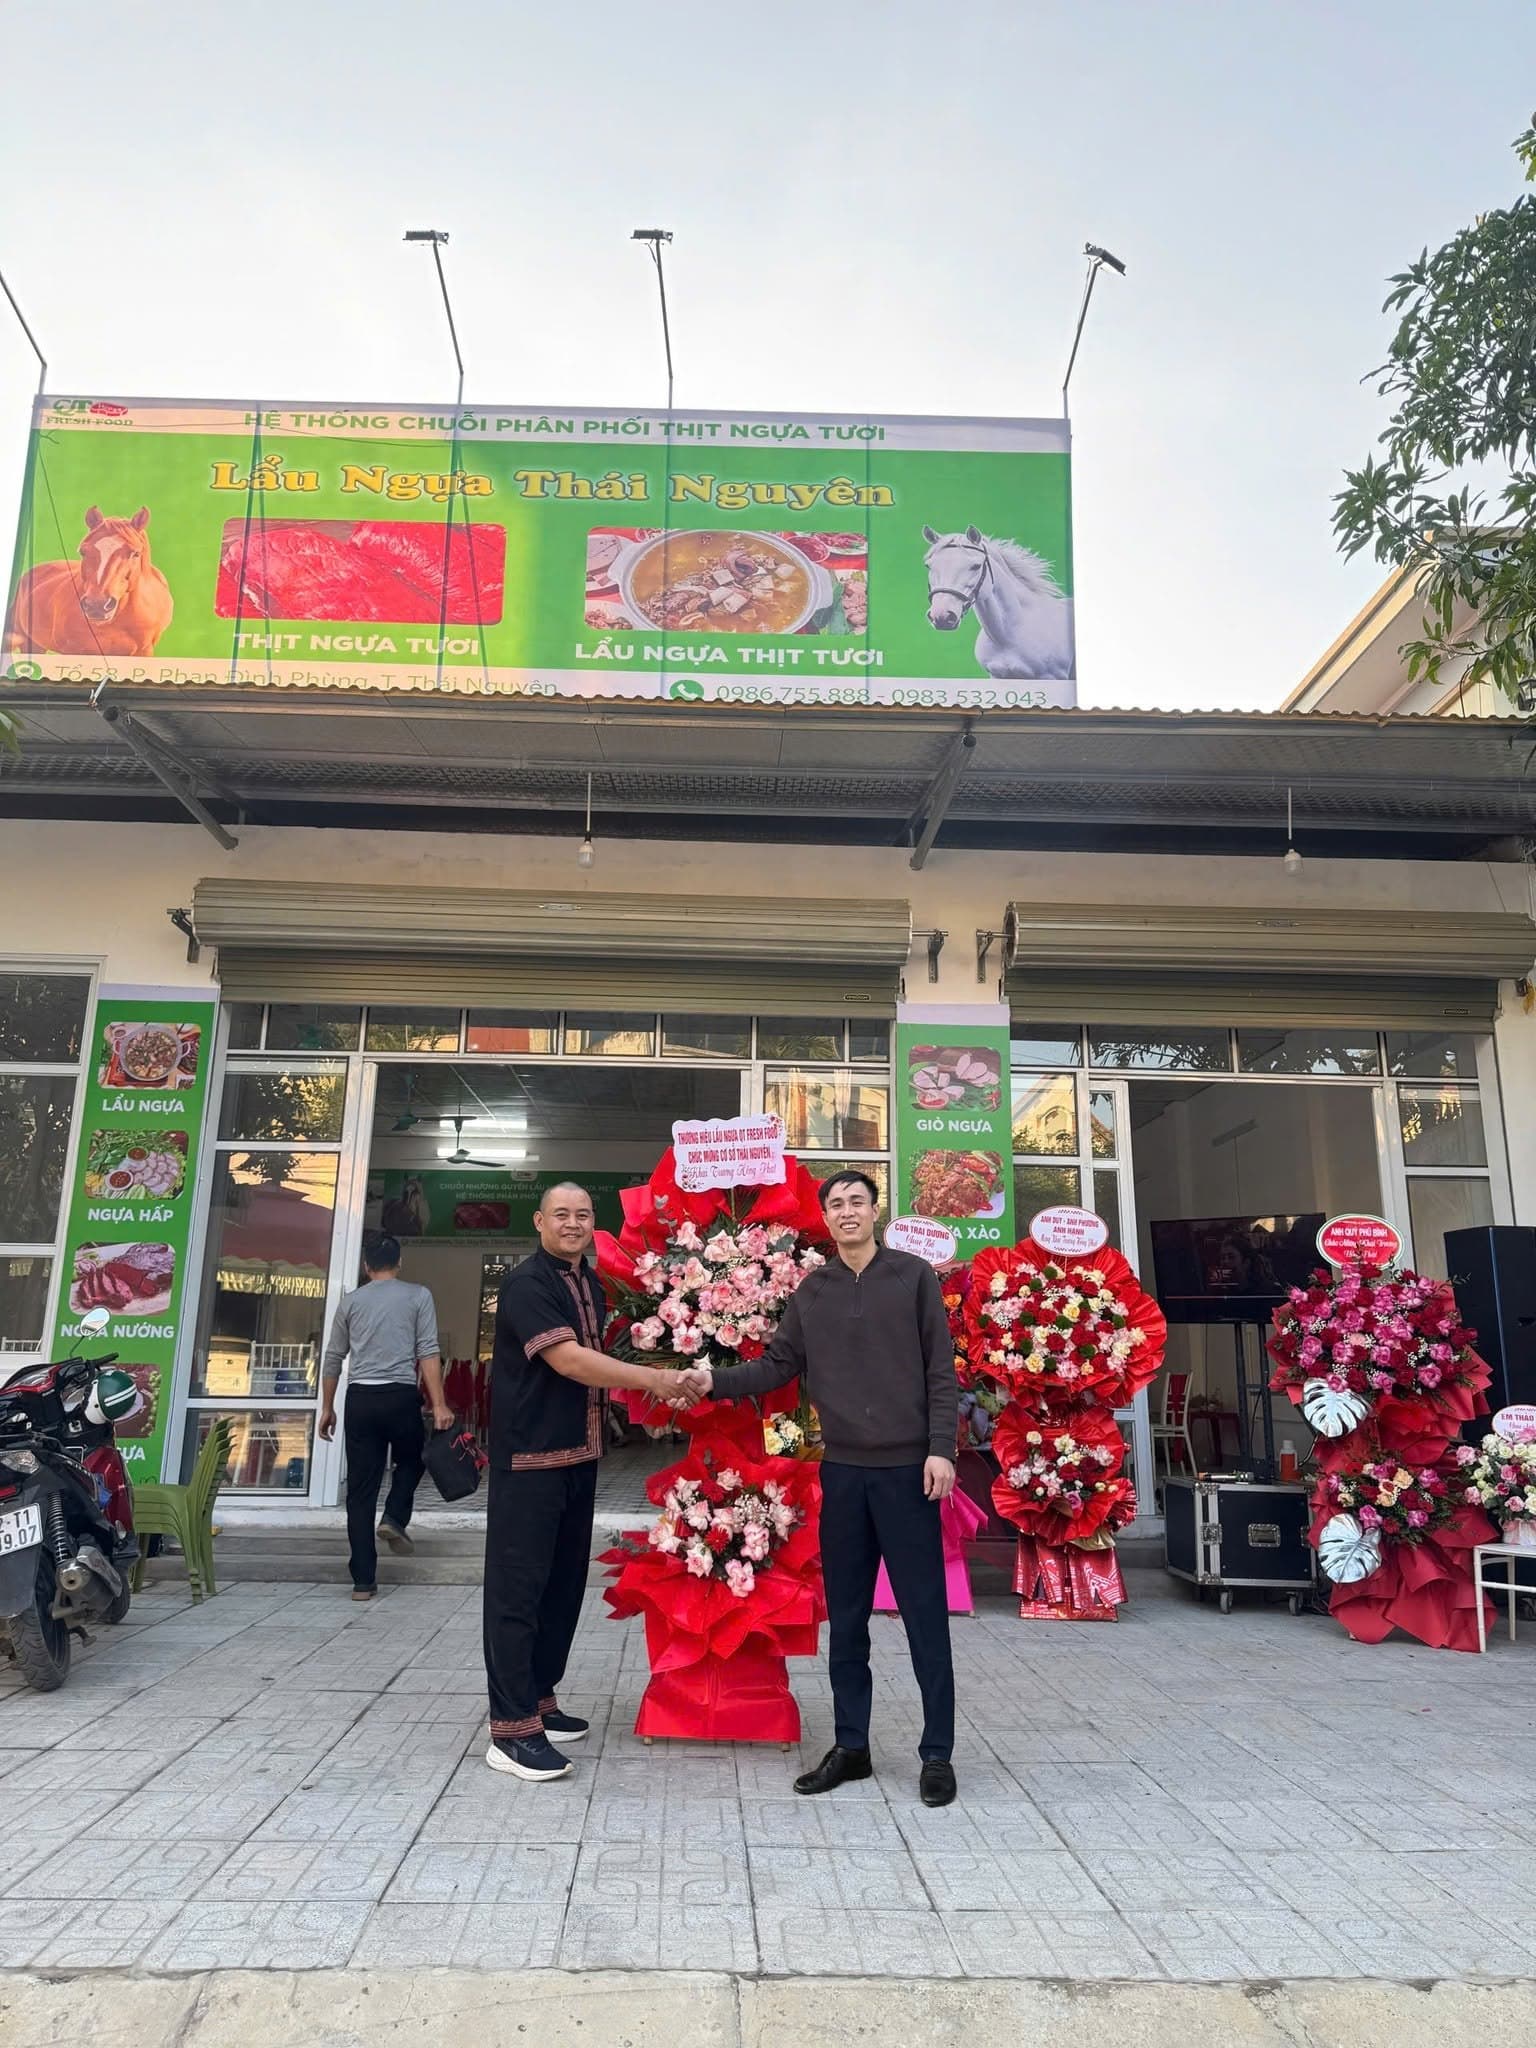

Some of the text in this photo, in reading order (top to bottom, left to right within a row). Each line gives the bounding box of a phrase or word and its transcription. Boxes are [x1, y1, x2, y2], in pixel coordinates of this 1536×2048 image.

[245, 410, 885, 441] HỆ THỐNG CHUỖI PHÂN PHỐI THỊT NGỰA TƯƠI
[210, 454, 895, 510] Lẩu Ngựa Thái Nguyên
[234, 633, 479, 656] THỊT NGỰA TƯƠI
[575, 637, 884, 667] LẨU NGỰA THỊT TƯƠI
[159, 667, 218, 682] Phan
[408, 675, 457, 690] Thái
[716, 685, 870, 702] 0986.755.888
[102, 1093, 185, 1115] LẨU NGỰA
[916, 1116, 993, 1135] GIÒ NGỰA
[88, 1204, 174, 1224] NGỰA HẤP
[894, 1223, 909, 1232] CON
[910, 1226, 925, 1236] TRAI
[926, 1228, 950, 1241] DƯƠNG
[967, 1224, 1000, 1240] XÀO
[1330, 1227, 1345, 1237] ANH
[61, 1321, 175, 1341] NGA NƯỚNG
[116, 1444, 146, 1463] ỰA
[0, 1525, 37, 1551] 9.07
